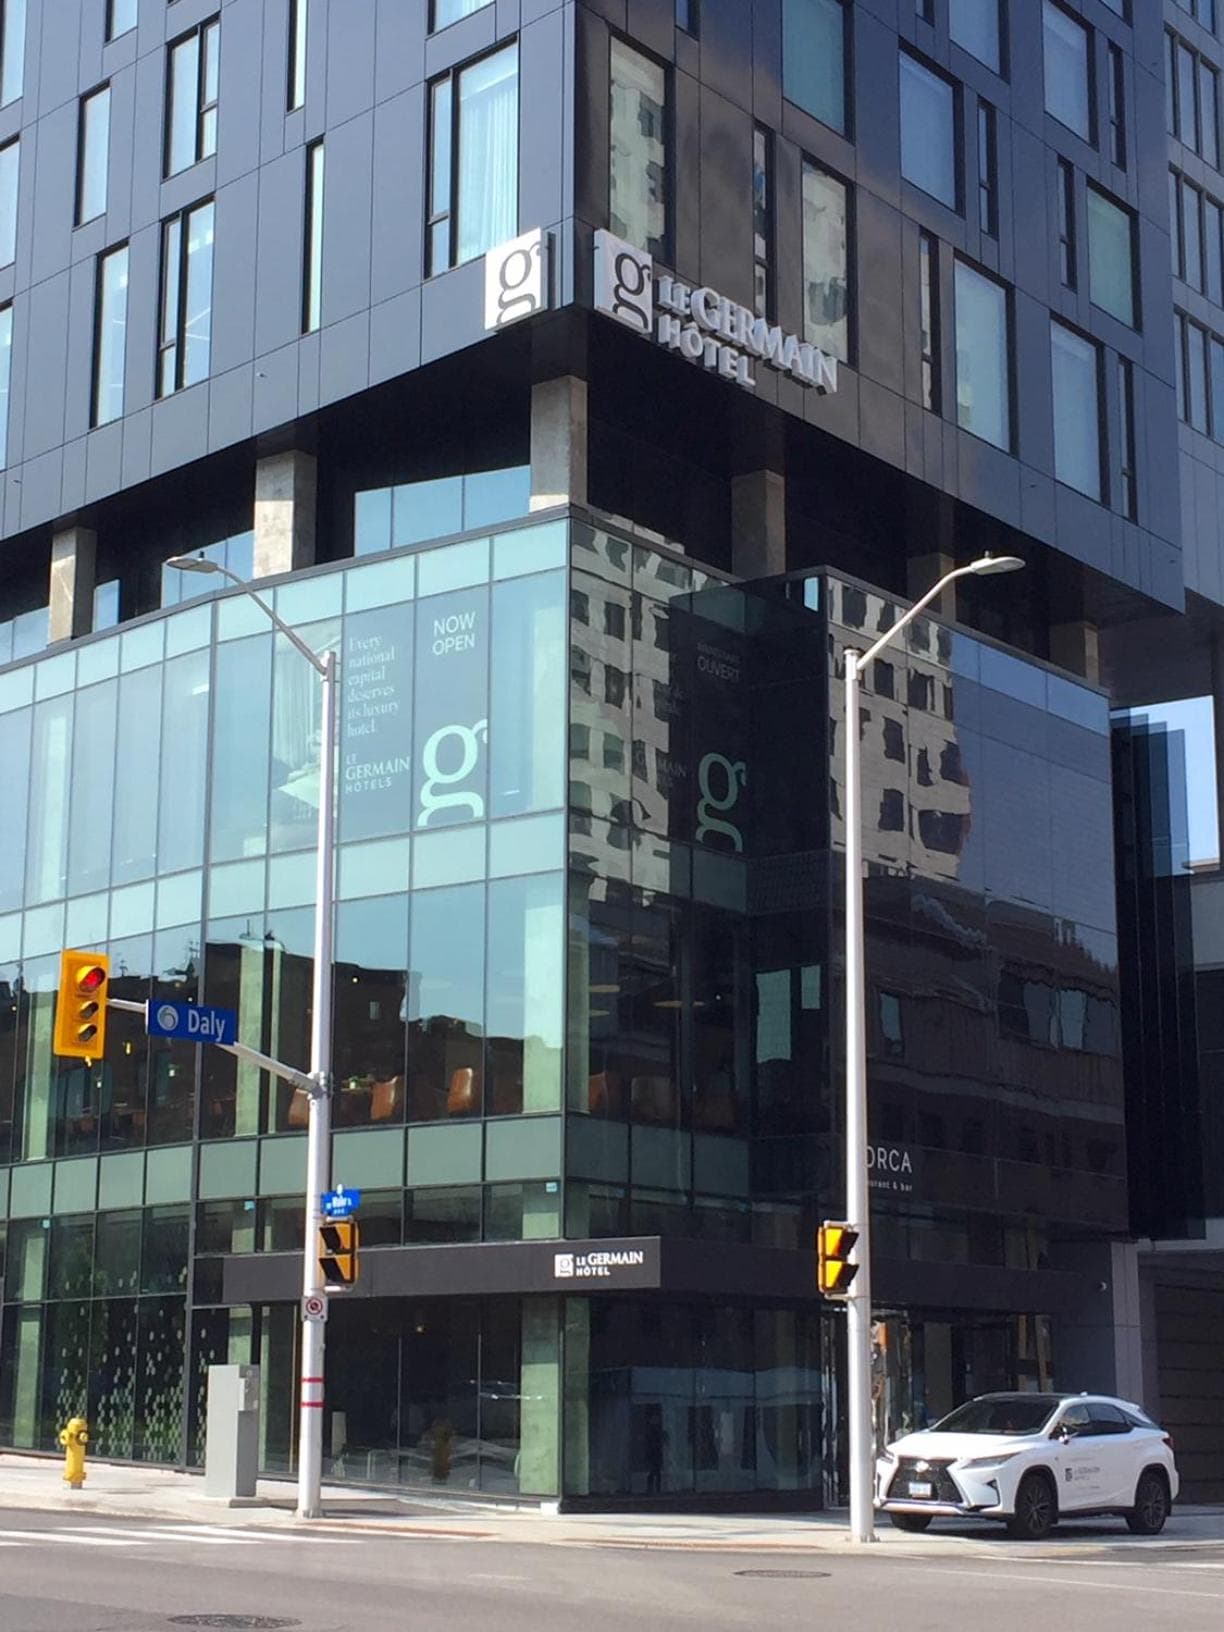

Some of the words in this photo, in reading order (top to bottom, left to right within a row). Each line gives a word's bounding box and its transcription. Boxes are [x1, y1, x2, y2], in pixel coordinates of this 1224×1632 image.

[691, 286, 838, 393] GERMAIN
[433, 611, 477, 637] NOW
[348, 645, 396, 668] national
[432, 633, 476, 656] OPEN
[348, 665, 386, 688] capital
[345, 756, 411, 780] GERMAIN
[187, 1009, 226, 1042] Daly
[866, 1145, 912, 1173] ORCA
[588, 1250, 644, 1265] GERMAIN
